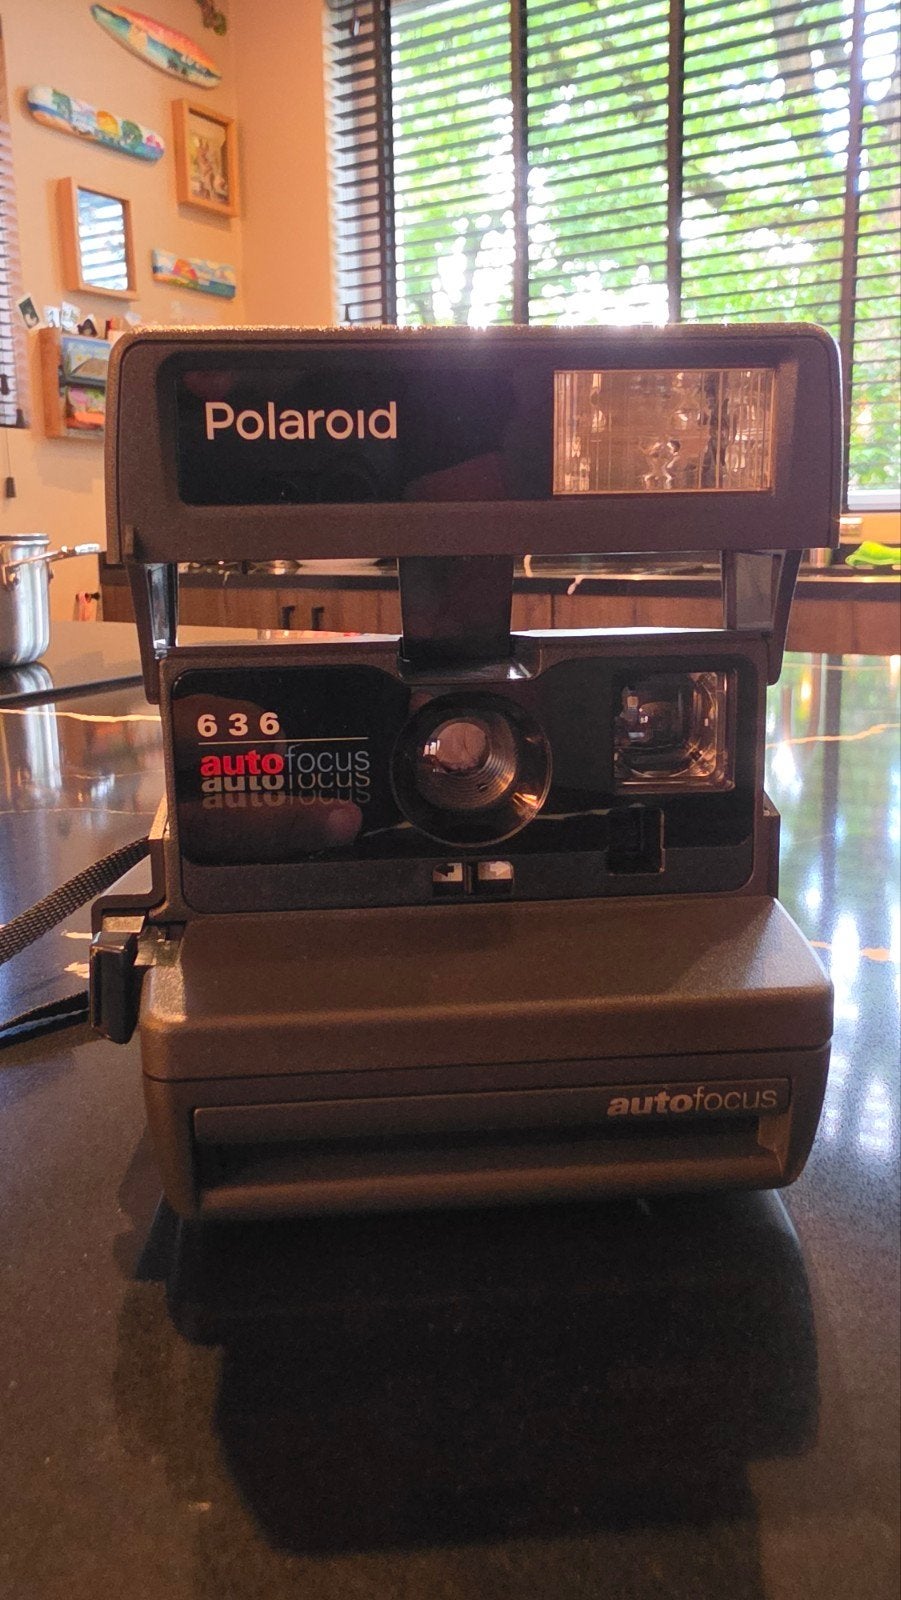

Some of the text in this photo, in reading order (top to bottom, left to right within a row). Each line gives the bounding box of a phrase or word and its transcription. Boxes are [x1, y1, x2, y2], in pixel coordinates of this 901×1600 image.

[205, 401, 397, 440] Polaroid
[200, 744, 370, 776] autofocus
[607, 1086, 777, 1117] autofocus
